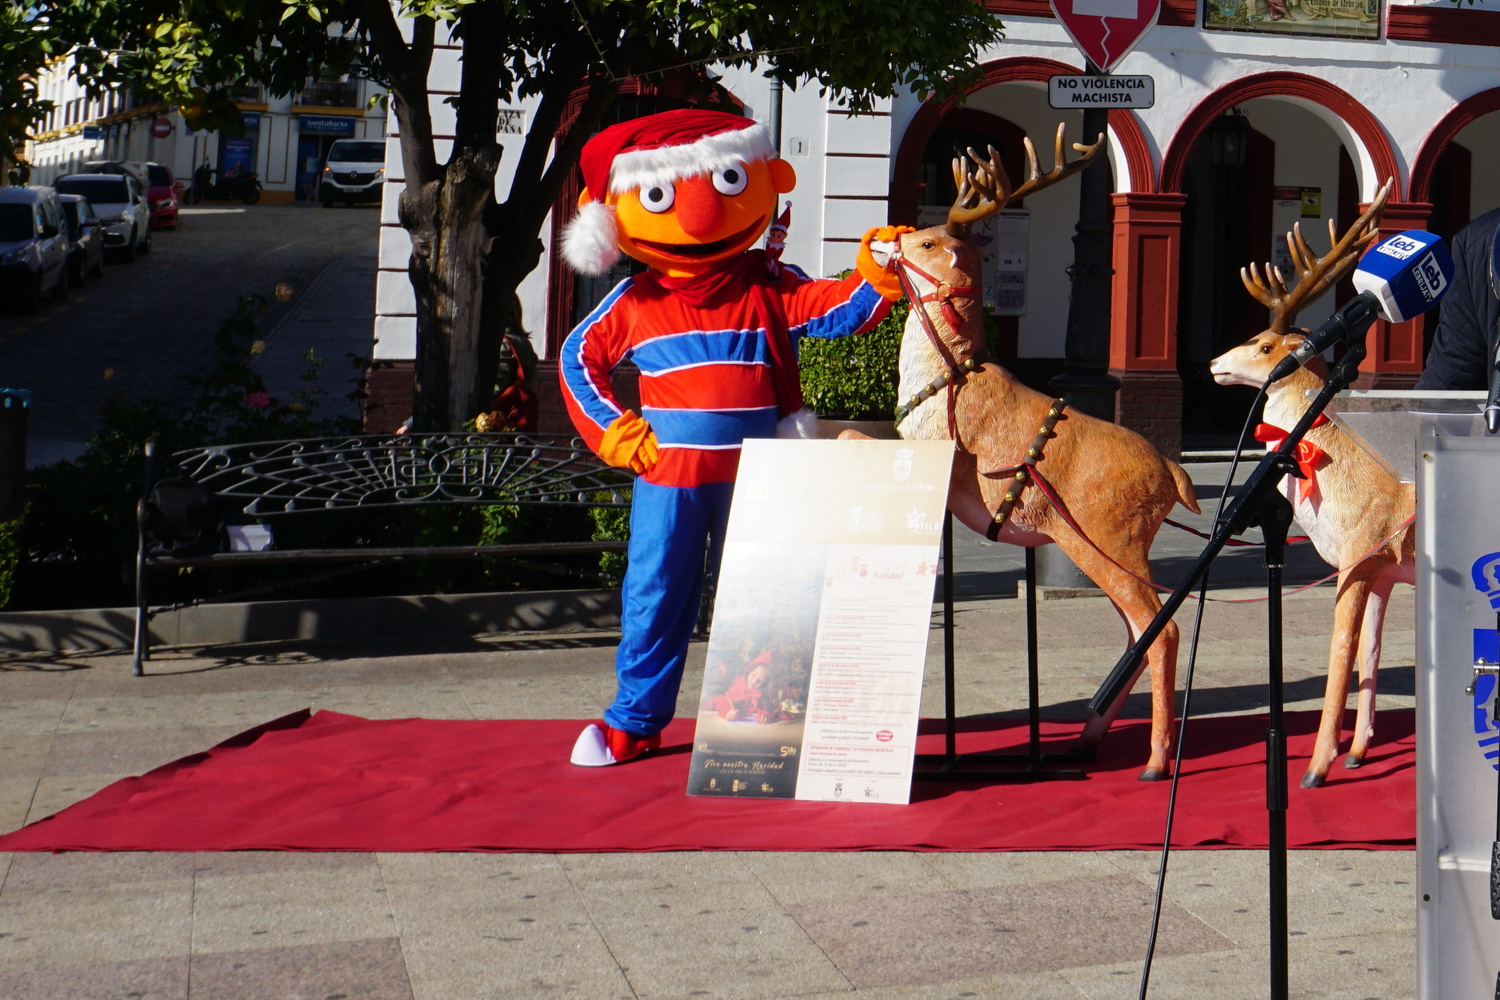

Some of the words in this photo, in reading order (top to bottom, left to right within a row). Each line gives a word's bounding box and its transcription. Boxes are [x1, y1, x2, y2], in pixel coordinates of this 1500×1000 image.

[1058, 79, 1078, 88] NO
[1082, 79, 1145, 88] VIOLENCIA
[1071, 93, 1133, 103] MACHISTA
[797, 141, 802, 153] 1
[1387, 237, 1416, 252] leb
[1420, 254, 1441, 291] leb
[1411, 266, 1434, 303] LEBRIJATV
[722, 760, 748, 768] nuestra
[751, 761, 785, 770] Navidad
